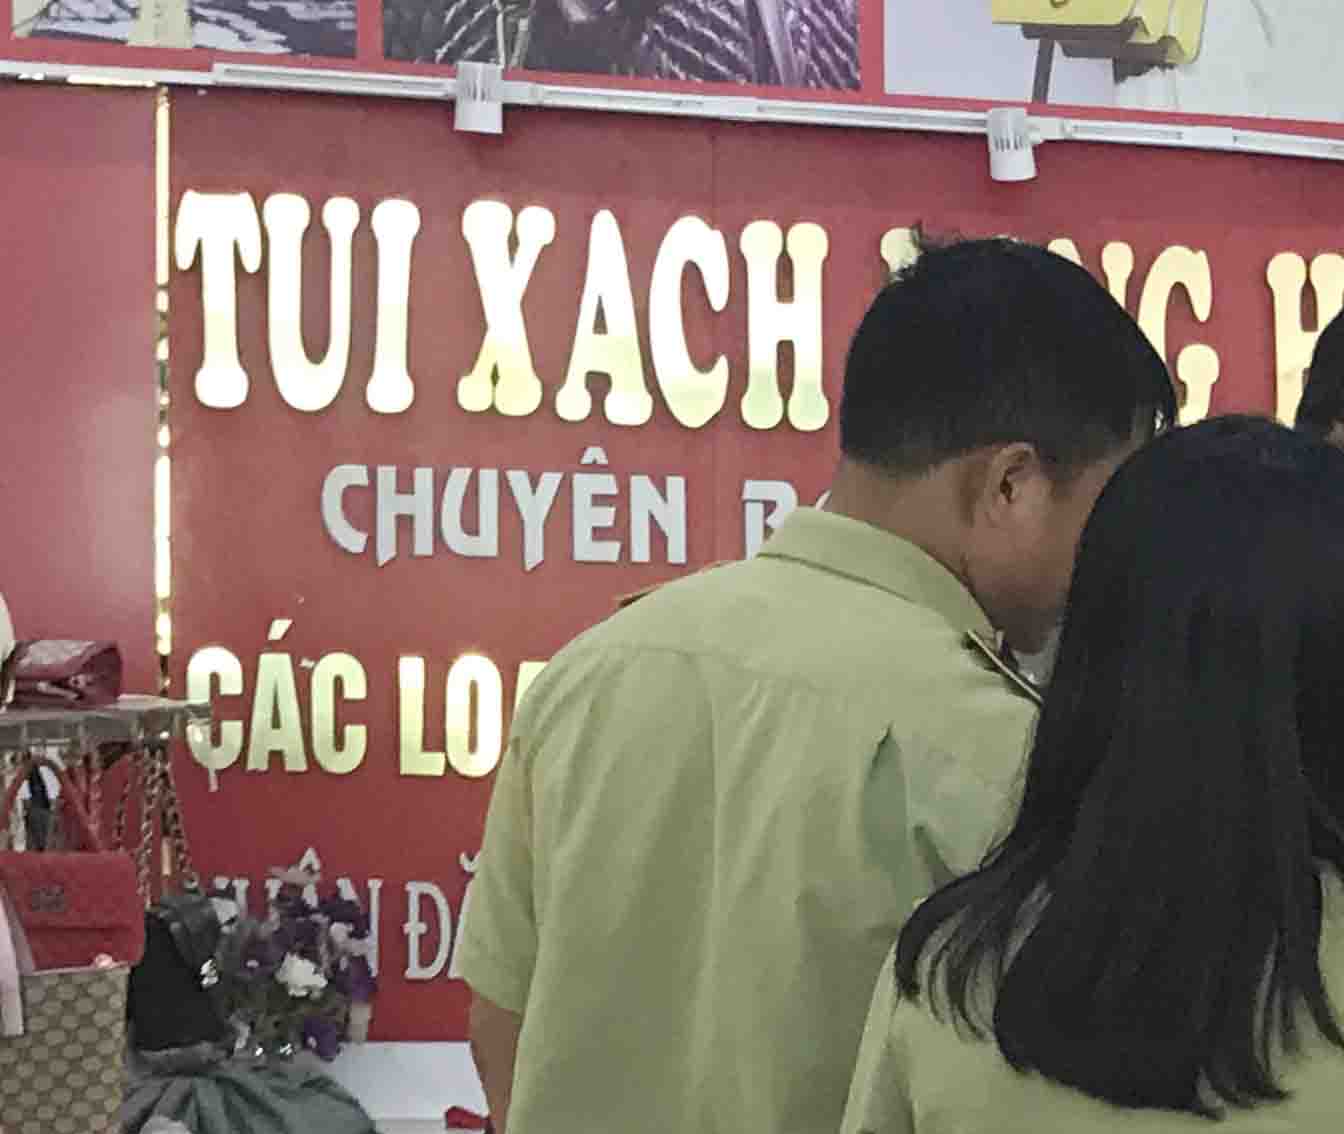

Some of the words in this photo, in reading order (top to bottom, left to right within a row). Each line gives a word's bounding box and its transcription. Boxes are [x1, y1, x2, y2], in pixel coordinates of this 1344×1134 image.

[174, 190, 421, 414] TUI
[457, 199, 832, 431] XACH
[321, 446, 687, 570] CHUYÊN
[185, 619, 368, 775] CÁC
